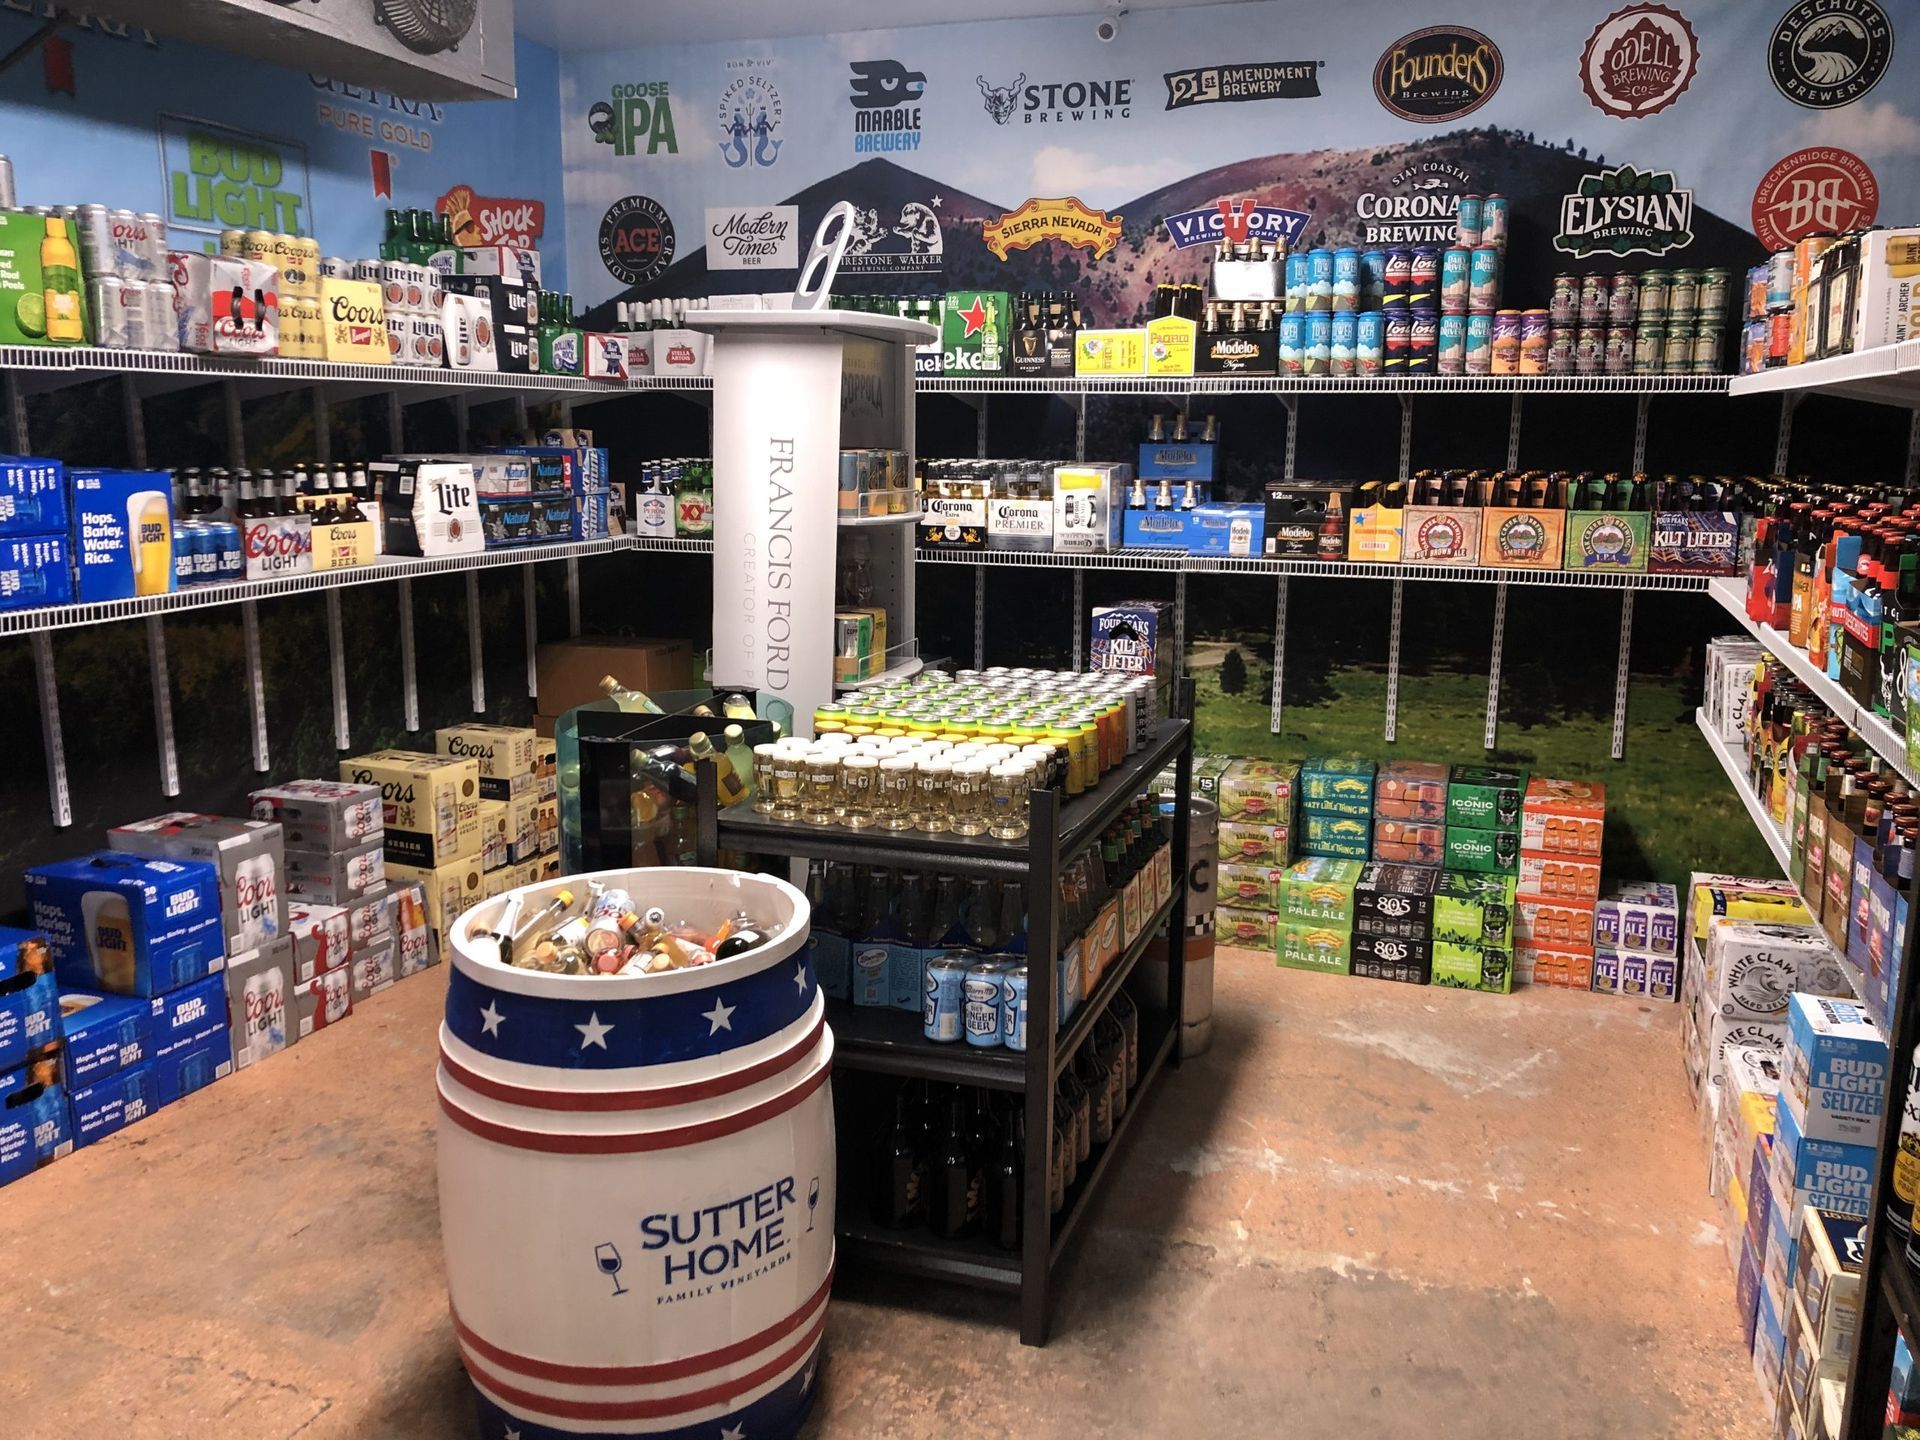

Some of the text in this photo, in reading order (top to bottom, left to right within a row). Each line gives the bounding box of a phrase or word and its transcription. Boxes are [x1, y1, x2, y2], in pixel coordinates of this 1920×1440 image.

[1779, 0, 1886, 43] DESCHUTES
[1610, 31, 1674, 74] ODELL
[1223, 66, 1311, 84] AMENDMENT
[1612, 66, 1672, 86] BREWING
[611, 81, 669, 99] GOOSE
[1023, 79, 1132, 111] STONE
[1223, 80, 1282, 97] BREWERY
[1402, 88, 1470, 99] Brewing
[1786, 75, 1867, 101] BREWERY
[719, 76, 782, 118] SPIKED SELTZER
[854, 107, 921, 133] MARBLE
[1023, 106, 1132, 124] BREWING
[319, 104, 431, 150] PURE GOLD
[613, 98, 679, 156] IPA
[854, 131, 921, 153] BREWERY
[190, 134, 282, 187] BUD
[1391, 162, 1471, 186] STAY COASTAL
[1758, 151, 1875, 204] BRECKENRIDGE BREWERY
[171, 170, 303, 235] LIGHT
[605, 198, 668, 224] PREMIUM
[479, 205, 536, 241] SHOCK
[1565, 193, 1692, 236] ELYSIAN
[712, 211, 788, 241] Modern
[1001, 215, 1103, 239] SIERRA NEVADA
[1176, 213, 1300, 237] VICTORY
[1593, 226, 1654, 240] BREWING
[1757, 217, 1774, 243] FINE
[614, 227, 661, 253] ACE
[722, 233, 780, 256] Times
[1184, 231, 1223, 243] BREWING
[601, 236, 636, 284] CIDERS
[647, 235, 674, 281] CRAFT
[742, 257, 762, 266] BEER
[839, 255, 942, 267] IRESTONE WALKER
[1411, 254, 1438, 273] Lost
[383, 267, 406, 282] Lite
[509, 292, 526, 311] Lite
[1899, 282, 1910, 312] ARCHER
[330, 296, 385, 324] Coors
[1411, 320, 1436, 337] Lost
[511, 340, 528, 358] Lite
[1216, 341, 1255, 354] Modelo
[1015, 356, 1045, 364] GUINNESS
[536, 464, 563, 477] Natural
[438, 483, 470, 516] Lite
[1272, 491, 1282, 499] 12
[546, 508, 571, 521] Natural
[932, 499, 972, 513] Corona
[999, 506, 1038, 518] Corona
[82, 513, 116, 526] Hops.
[503, 511, 530, 526] Natural
[995, 520, 1045, 530] PREMIER
[1145, 516, 1178, 529] Modelo
[1656, 517, 1688, 526] FOUR PEAKS
[83, 526, 124, 538] Barley.
[141, 523, 161, 533] BUD
[330, 527, 357, 541] Coors
[1281, 527, 1310, 537] Modelo
[84, 538, 123, 550] Water.
[246, 523, 311, 558] Coors
[1654, 531, 1732, 548] KILT LIFTER
[84, 552, 113, 564] Rice.
[331, 558, 358, 567] BEER
[1527, 550, 1540, 558] ALE
[262, 555, 298, 571] LIGHT
[766, 437, 794, 691] FRANCIS FORD
[742, 532, 756, 658] CREATOR OF
[1110, 640, 1136, 655] KILT
[1102, 654, 1143, 671] LIFTER
[448, 736, 495, 758] Coors
[1201, 778, 1212, 788] 15
[1338, 801, 1358, 814] THING
[1359, 807, 1369, 815] IPA
[1452, 799, 1494, 809] ICONIC
[388, 839, 421, 850] SERIES
[1335, 843, 1355, 855] THING
[1356, 847, 1366, 855] IPA
[1451, 842, 1492, 852] ICONIC
[1711, 876, 1771, 884] Natural
[144, 886, 157, 896] 30
[33, 901, 65, 917] Hops.
[1288, 905, 1345, 920] PALE ALE
[1377, 897, 1411, 914] 805
[36, 915, 75, 933] Barley.
[1625, 923, 1646, 937] ALE
[1652, 926, 1674, 941] ALE
[1285, 950, 1342, 966] PALE ALE
[1374, 941, 1408, 958] 805
[1624, 968, 1644, 984] ALE
[1728, 952, 1796, 989] WHITE CLAW
[1651, 972, 1672, 987] ALE
[152, 998, 164, 1007] 30
[967, 1020, 991, 1031] BEER
[75, 1042, 119, 1064] Hops. Barley.
[76, 1055, 117, 1074] Water. Rice.
[1830, 1058, 1883, 1076] BUD
[81, 1099, 124, 1122] Hops. Barley.
[1821, 1091, 1882, 1116] SELTZER
[81, 1117, 104, 1132] Water.
[1, 1152, 21, 1163] Rice.
[1816, 1161, 1868, 1182] BUD
[640, 1176, 796, 1250] SUTTER
[664, 1217, 785, 1285] HOME
[657, 1253, 792, 1305] FAMILY VINEYARDS
